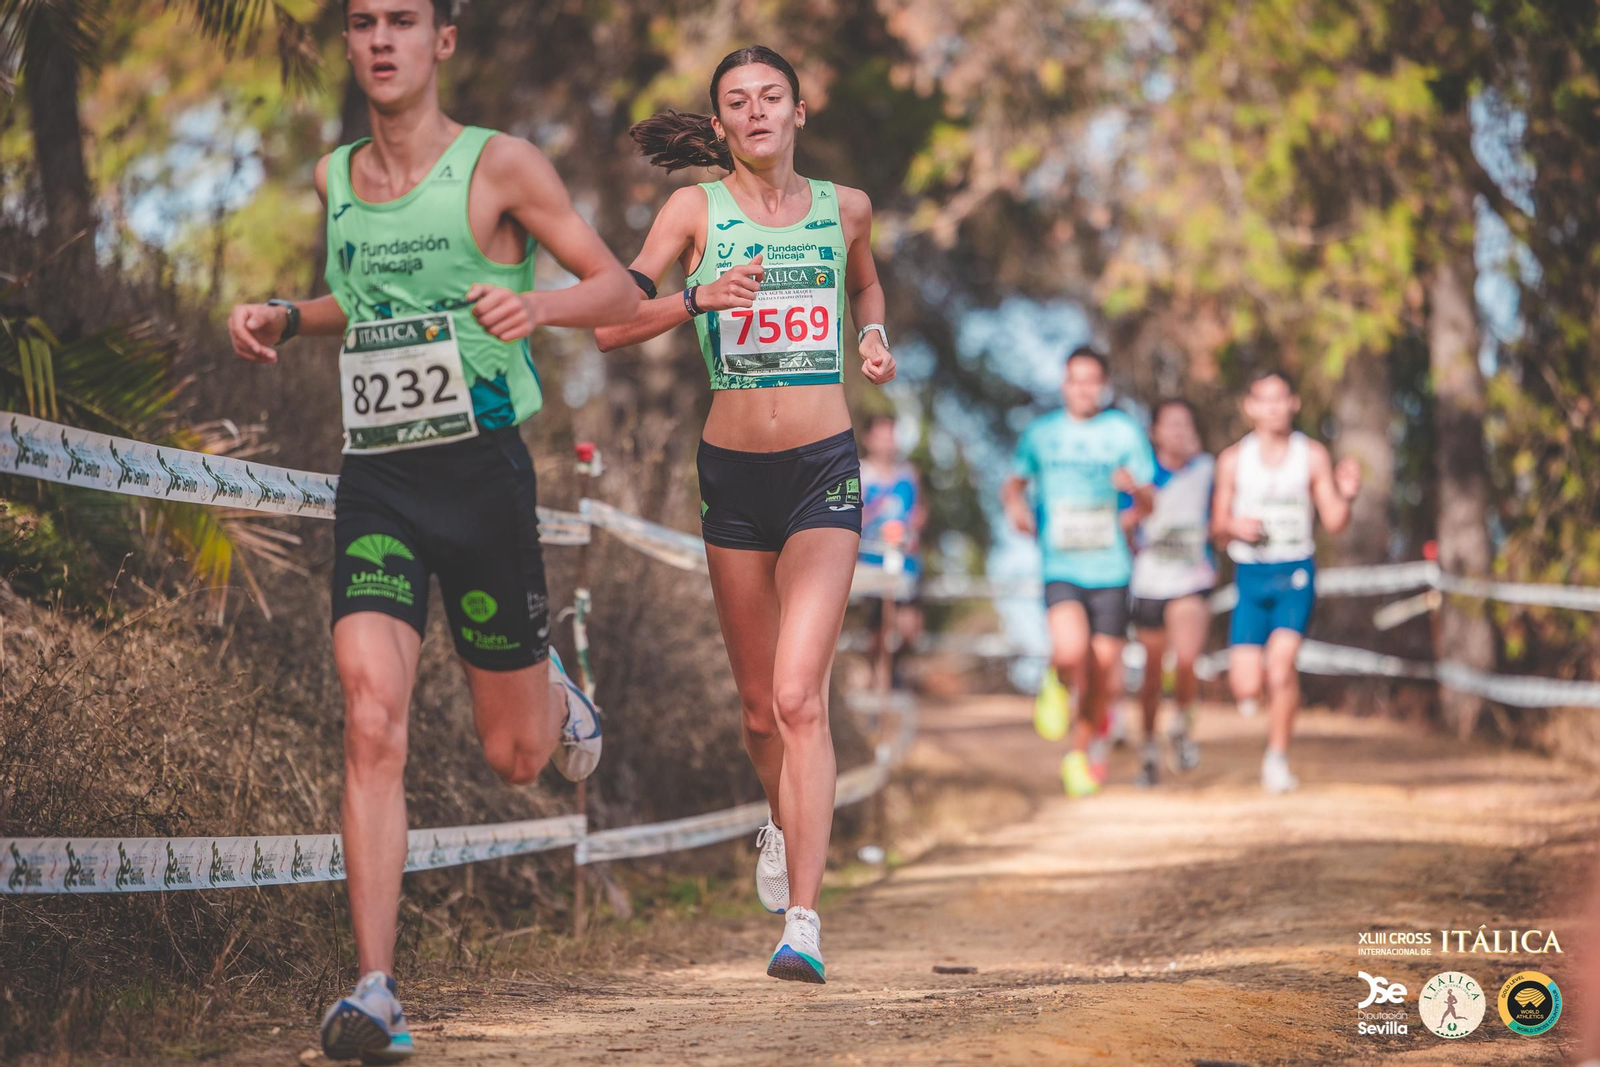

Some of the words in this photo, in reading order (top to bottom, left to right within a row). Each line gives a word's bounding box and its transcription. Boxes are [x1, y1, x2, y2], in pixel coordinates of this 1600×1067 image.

[360, 235, 450, 258] Fundación
[767, 243, 818, 252] Fundación
[767, 252, 805, 261] Unicaja
[361, 256, 423, 276] Unicaja
[731, 306, 829, 345] 7569
[353, 365, 457, 415] 8232
[351, 568, 412, 591] Unicaja
